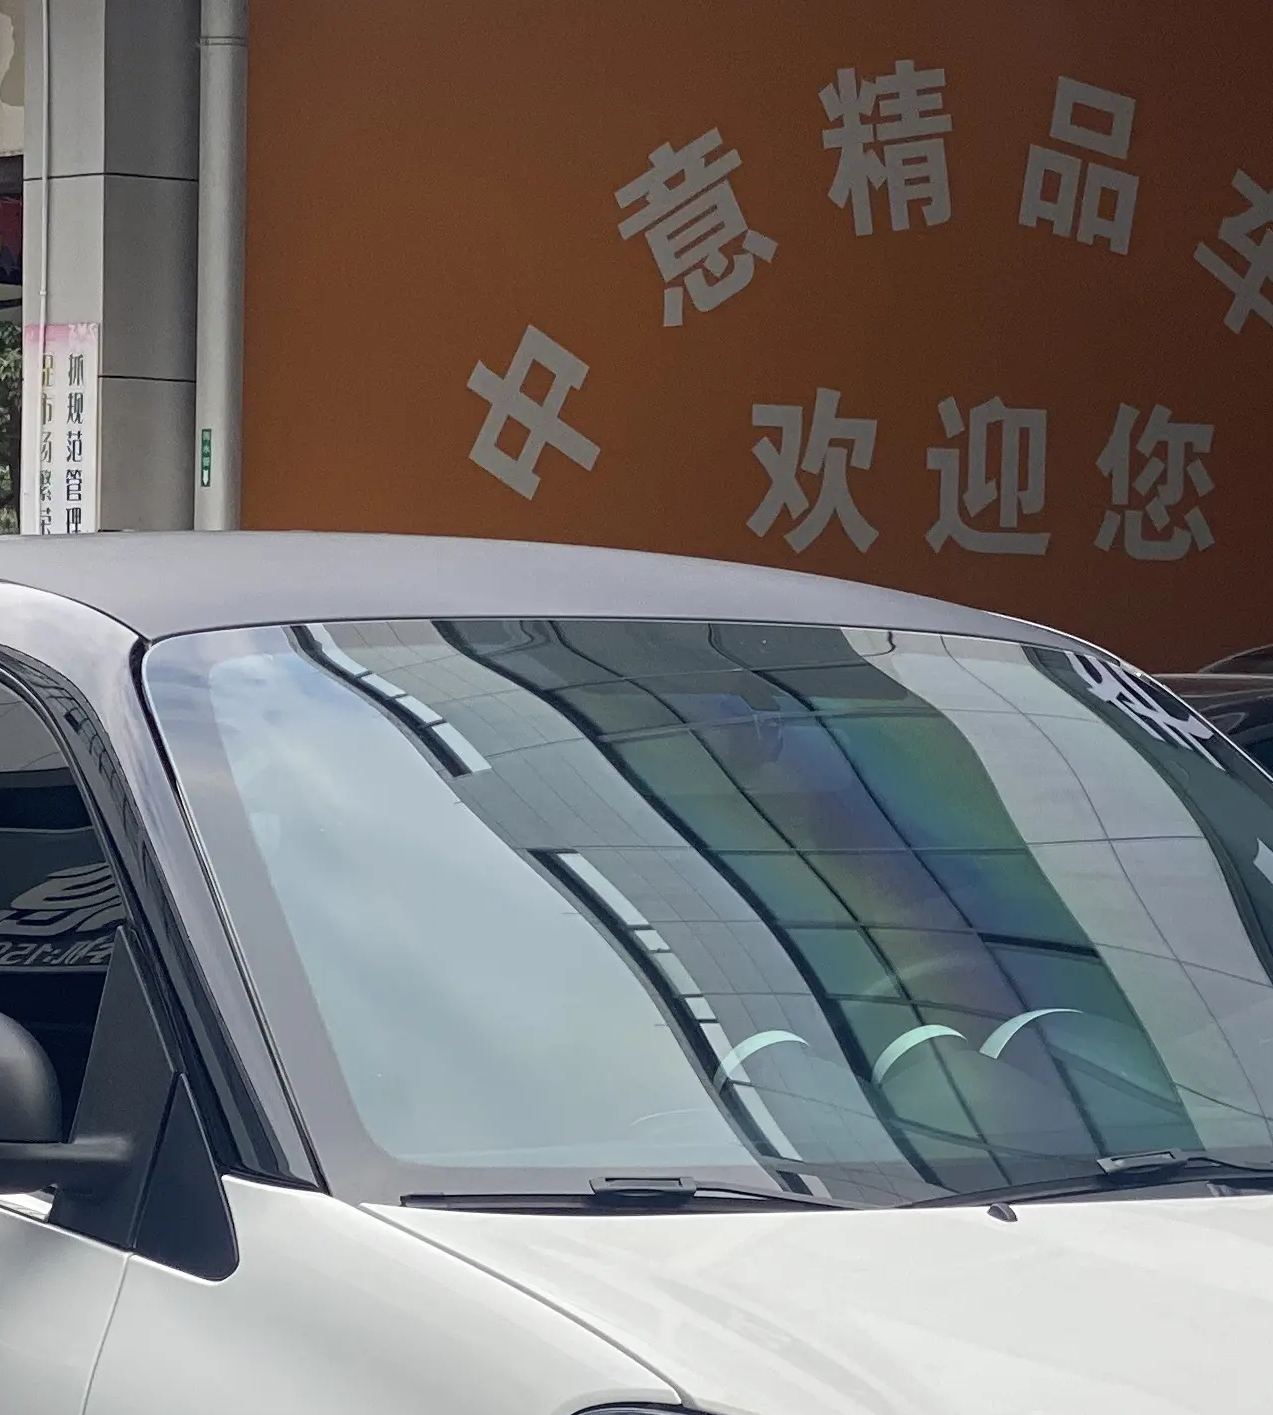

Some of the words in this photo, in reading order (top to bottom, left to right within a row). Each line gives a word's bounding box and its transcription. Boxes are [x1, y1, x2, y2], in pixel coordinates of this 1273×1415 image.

[65, 353, 84, 535] 抓规范管理
[746, 387, 1216, 562] 欢迎您
